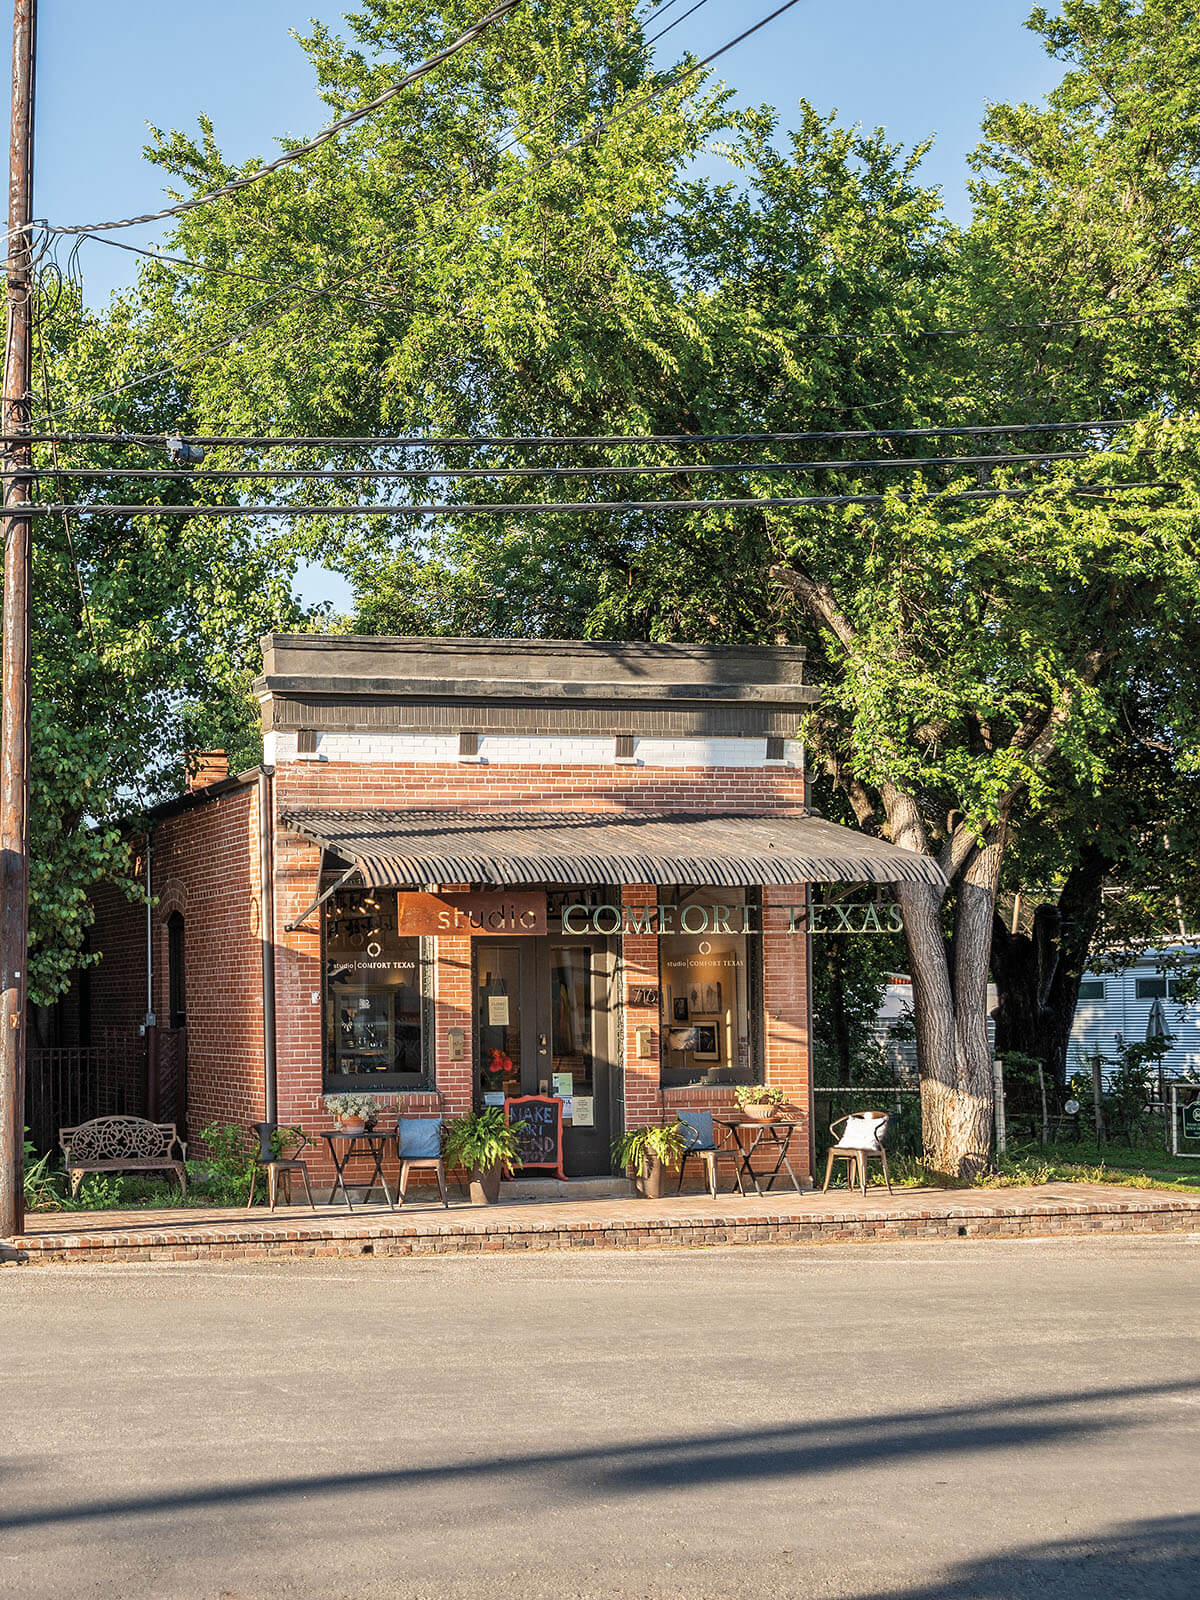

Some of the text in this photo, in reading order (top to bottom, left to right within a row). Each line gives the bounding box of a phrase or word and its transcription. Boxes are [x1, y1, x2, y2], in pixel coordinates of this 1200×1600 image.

[437, 905, 537, 929] studio
[563, 903, 904, 935] COMFORT TEXAS
[632, 988, 656, 1004] 716
[509, 1106, 553, 1123] MAKE
